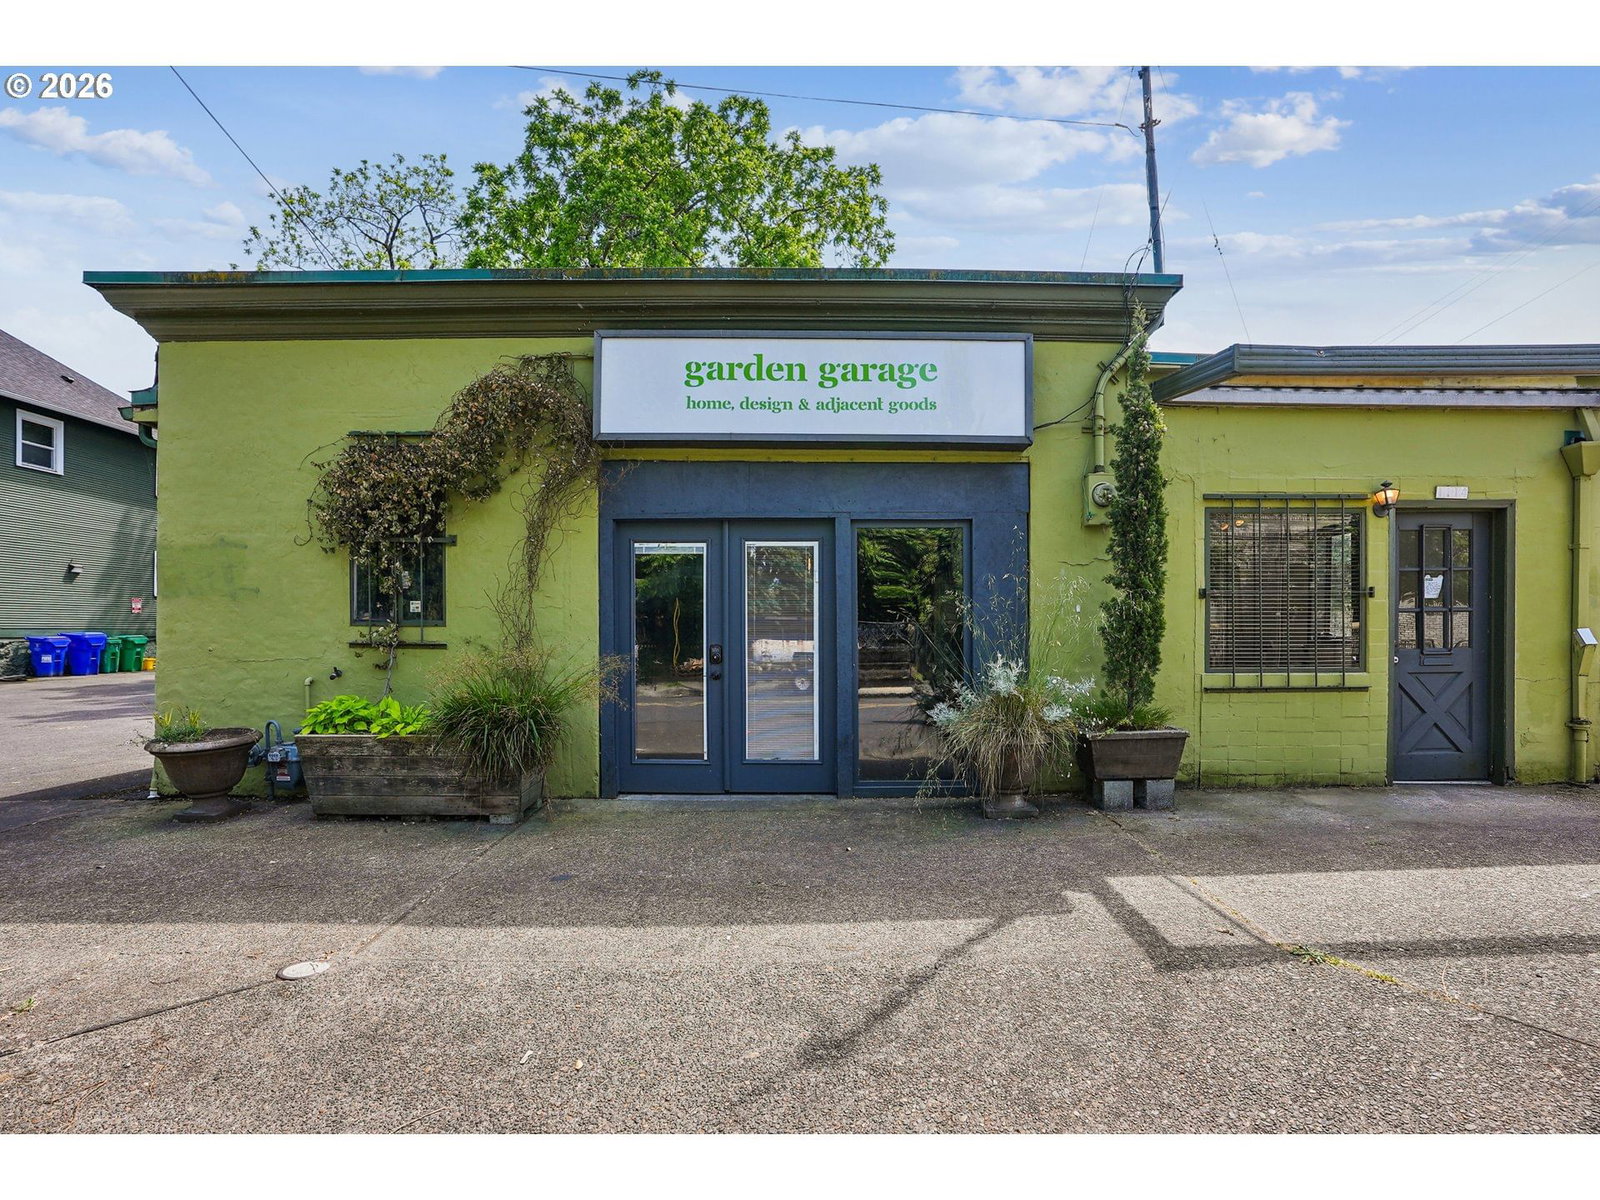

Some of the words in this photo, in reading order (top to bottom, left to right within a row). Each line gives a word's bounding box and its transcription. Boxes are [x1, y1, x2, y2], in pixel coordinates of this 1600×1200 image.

[685, 354, 807, 388] garden
[818, 363, 938, 390] garage
[686, 395, 735, 411] home,
[740, 395, 793, 413] design
[798, 397, 810, 411] &
[816, 396, 883, 414] adjacent
[888, 396, 938, 414] goods
